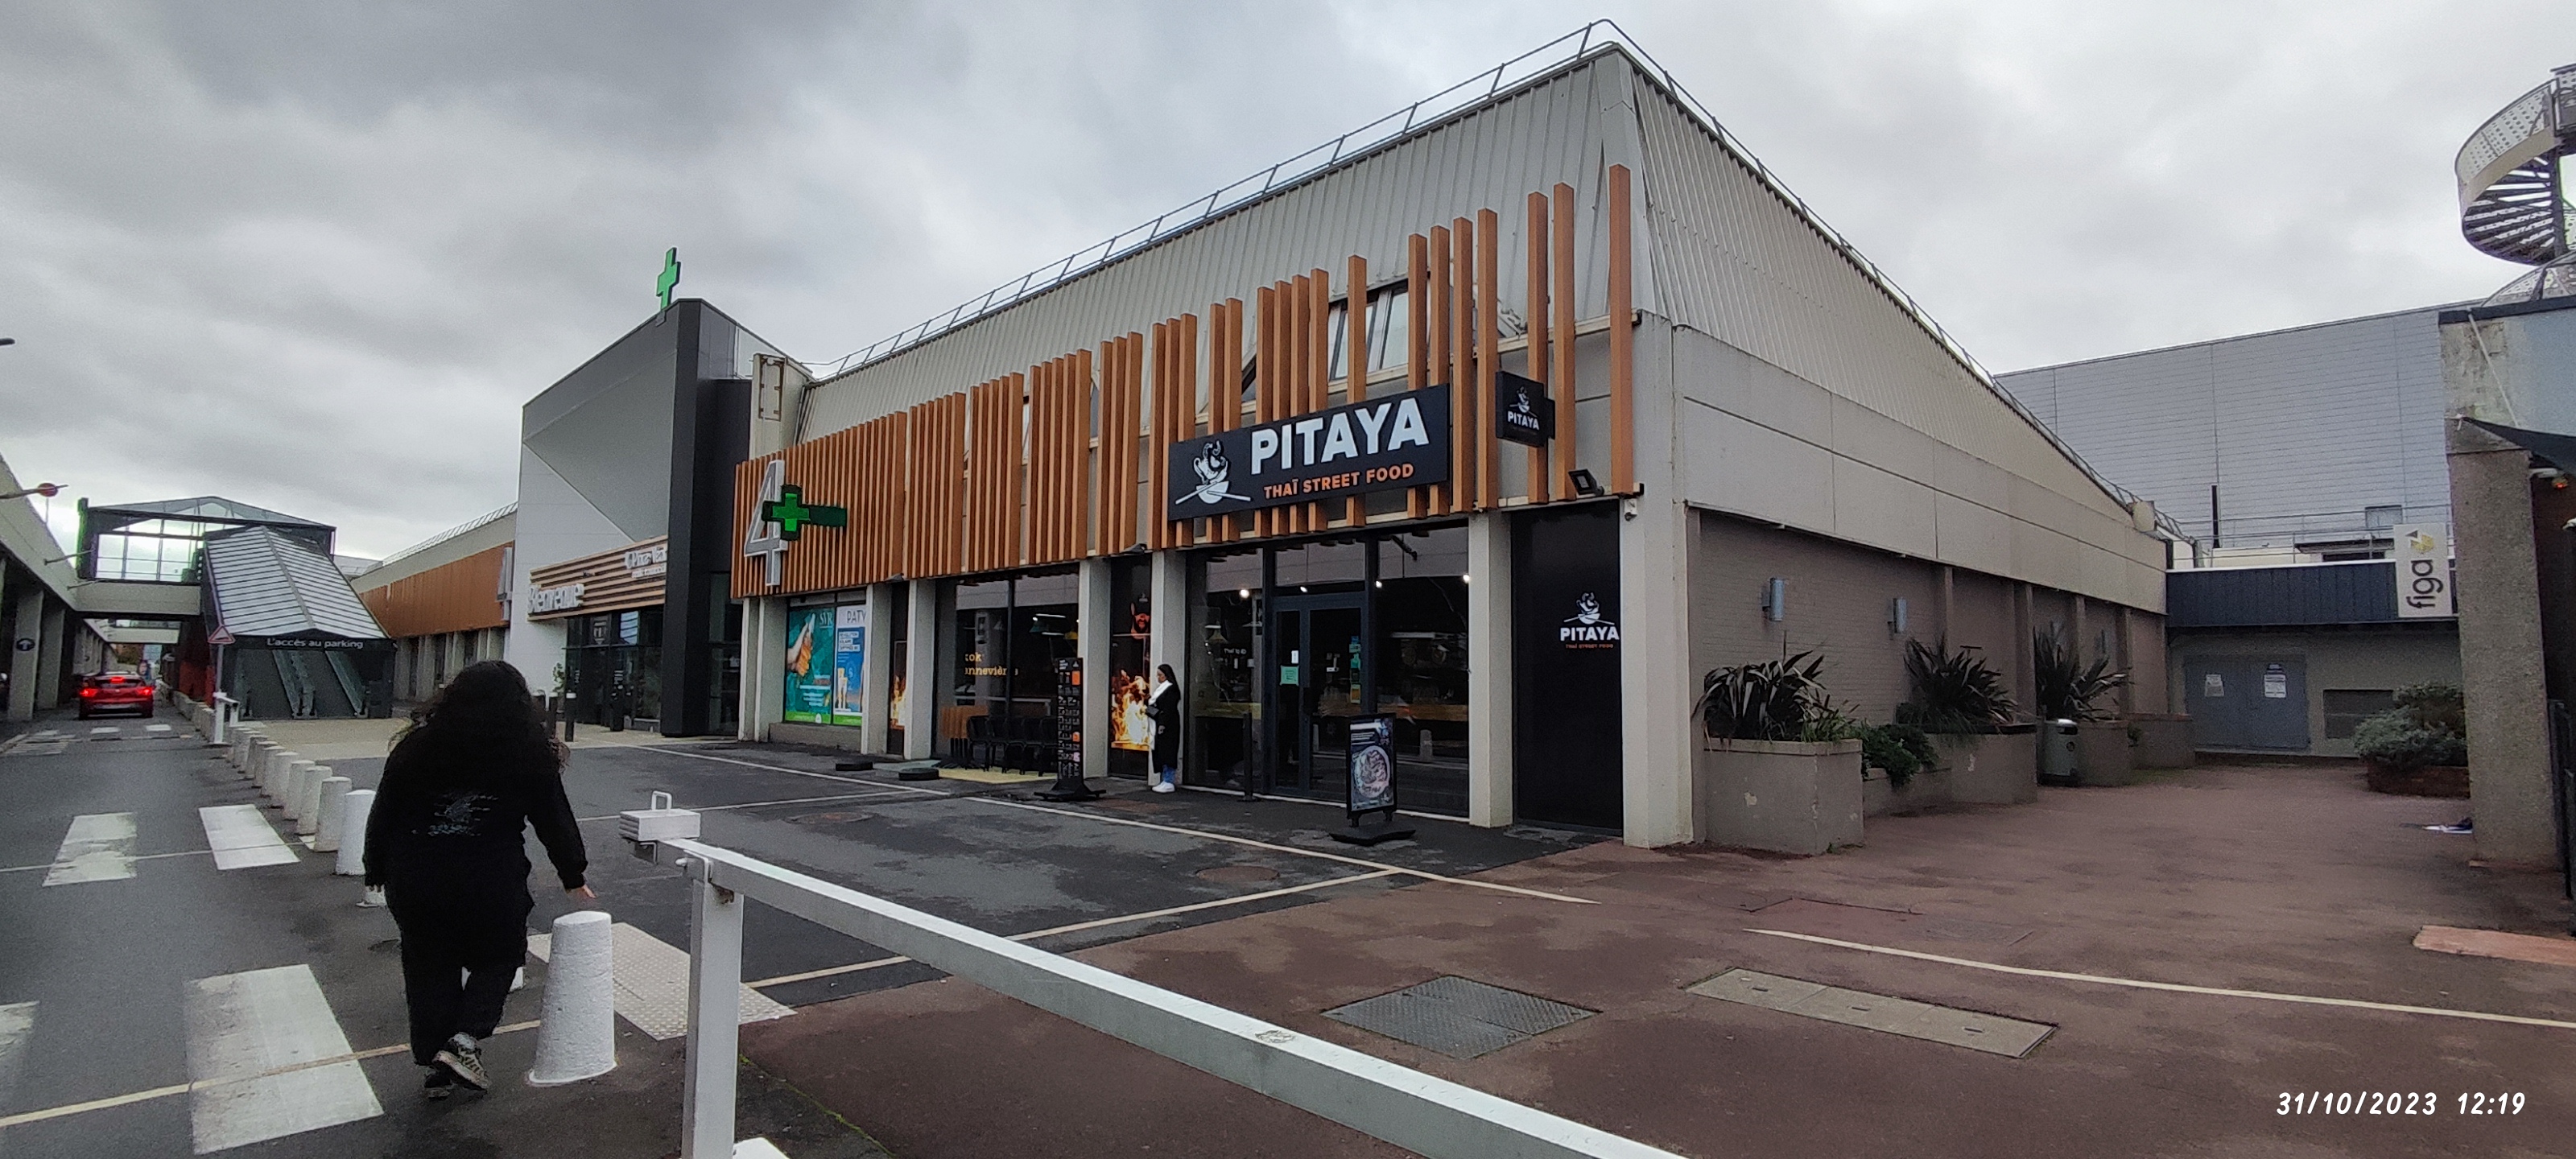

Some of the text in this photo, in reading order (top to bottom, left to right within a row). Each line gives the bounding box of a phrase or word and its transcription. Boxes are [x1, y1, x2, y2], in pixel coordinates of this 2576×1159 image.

[1507, 410, 1540, 431] PITAYA
[1250, 397, 1430, 475] PITAYA
[1264, 463, 1414, 500] THAÏ STREET FOOD
[2405, 559, 2444, 609] figa
[308, 639, 322, 647] au
[324, 639, 364, 649] parking
[1560, 626, 1620, 641] PITAYA
